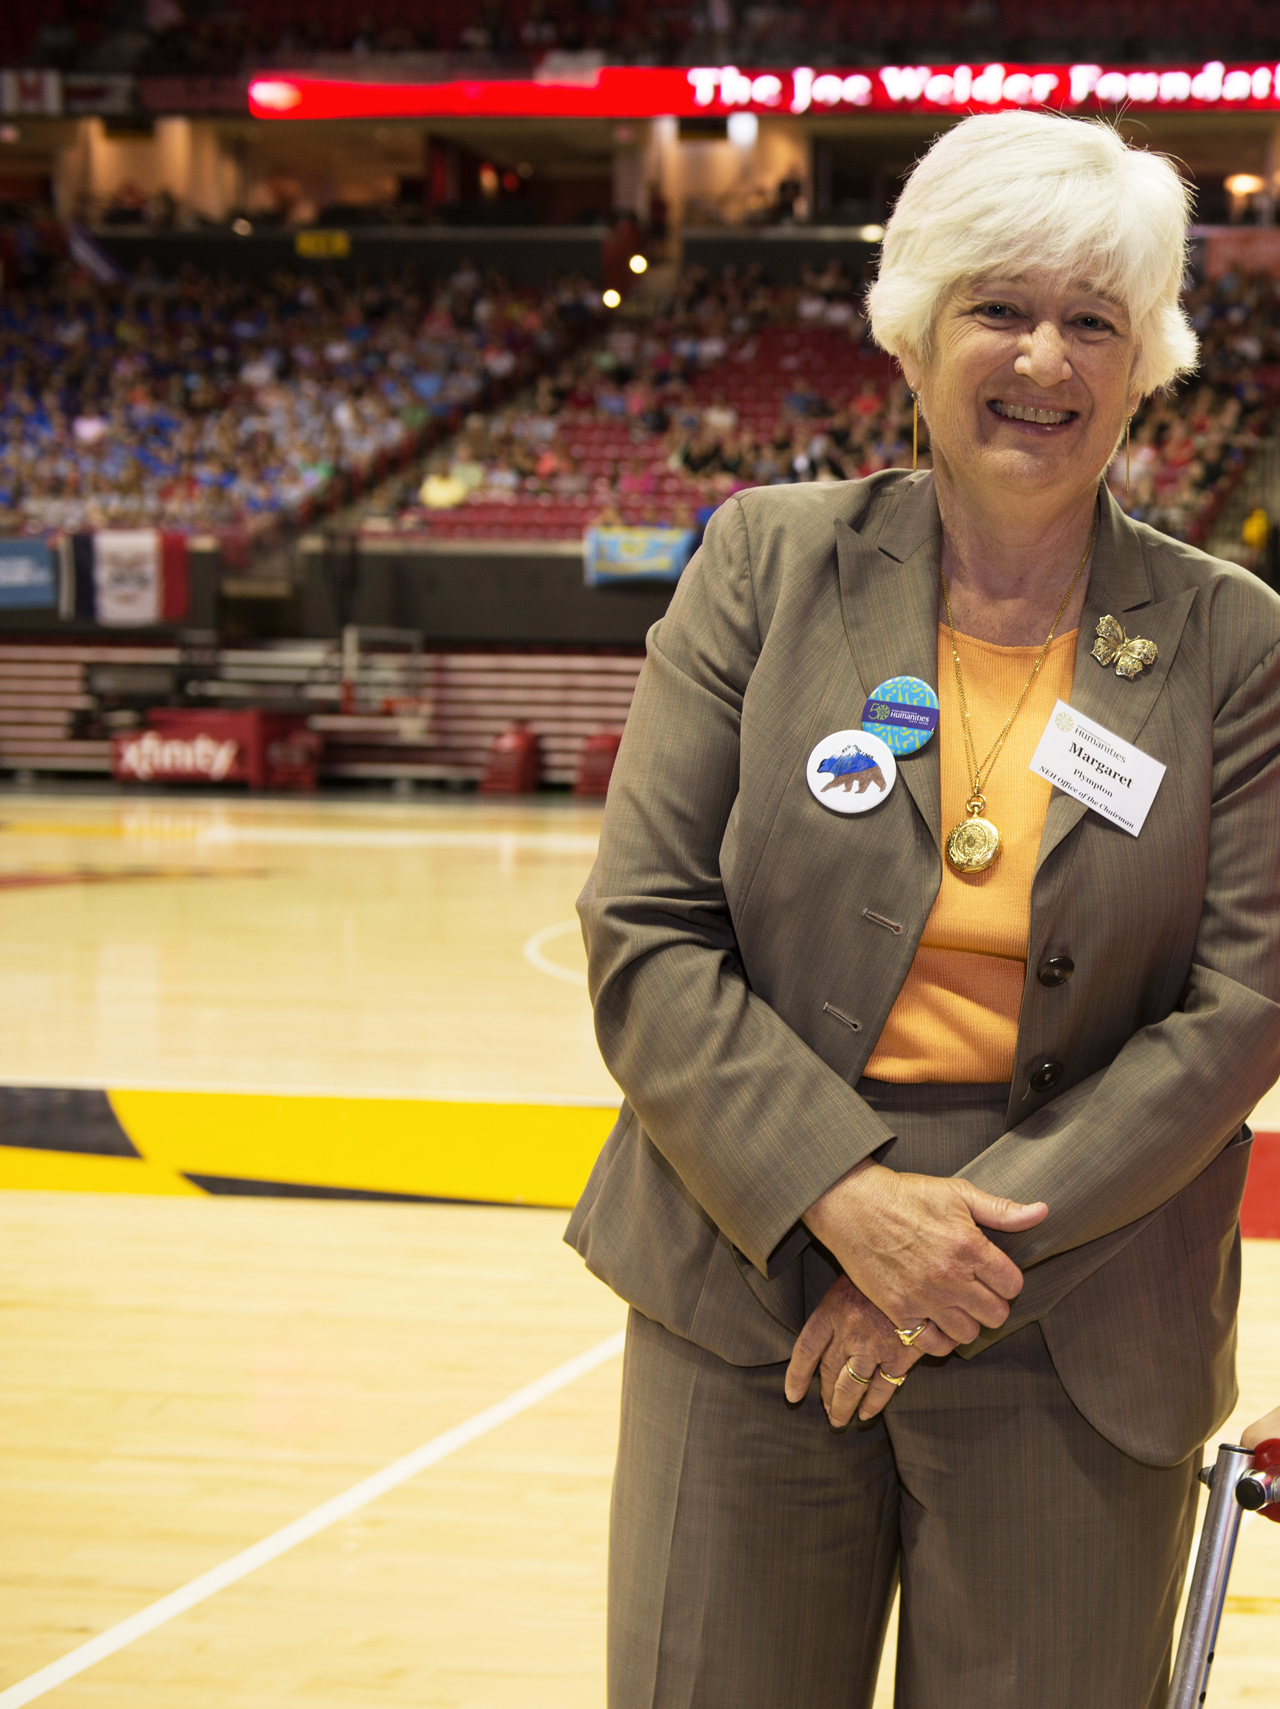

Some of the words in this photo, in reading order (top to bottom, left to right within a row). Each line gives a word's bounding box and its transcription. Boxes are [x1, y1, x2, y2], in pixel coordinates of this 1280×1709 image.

[687, 65, 782, 106] The
[790, 66, 872, 114] Joe
[890, 711, 930, 722] Humanities
[119, 731, 239, 781] xfinity
[1068, 741, 1133, 789] Margaret
[1074, 727, 1127, 763] Humanities
[1039, 766, 1057, 780] NEH
[1057, 777, 1078, 793] Office
[1079, 790, 1087, 799] of
[1087, 795, 1099, 807] the
[1099, 803, 1135, 828] Chairman
[1073, 768, 1113, 797] Plympton
